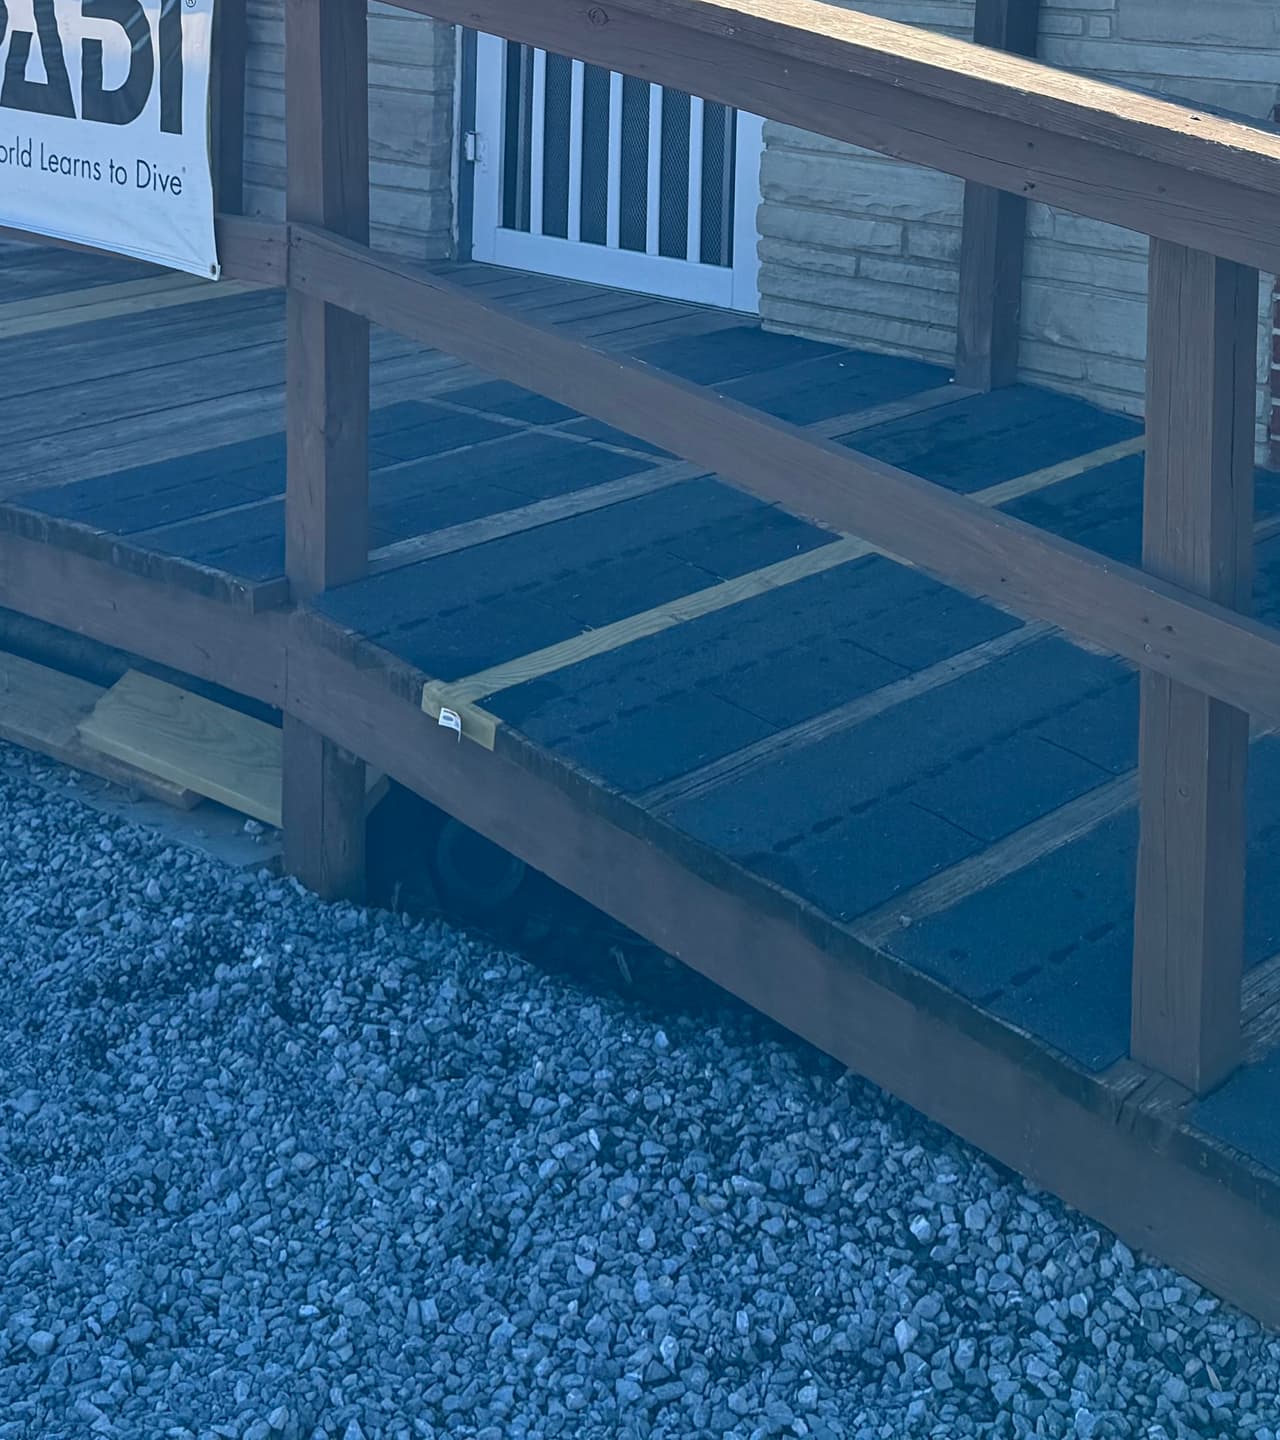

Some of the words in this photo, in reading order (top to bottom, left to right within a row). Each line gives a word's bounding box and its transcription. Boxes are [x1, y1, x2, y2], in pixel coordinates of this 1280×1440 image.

[40, 142, 102, 181] Learns
[109, 159, 128, 186] to
[136, 161, 183, 195] Dive
